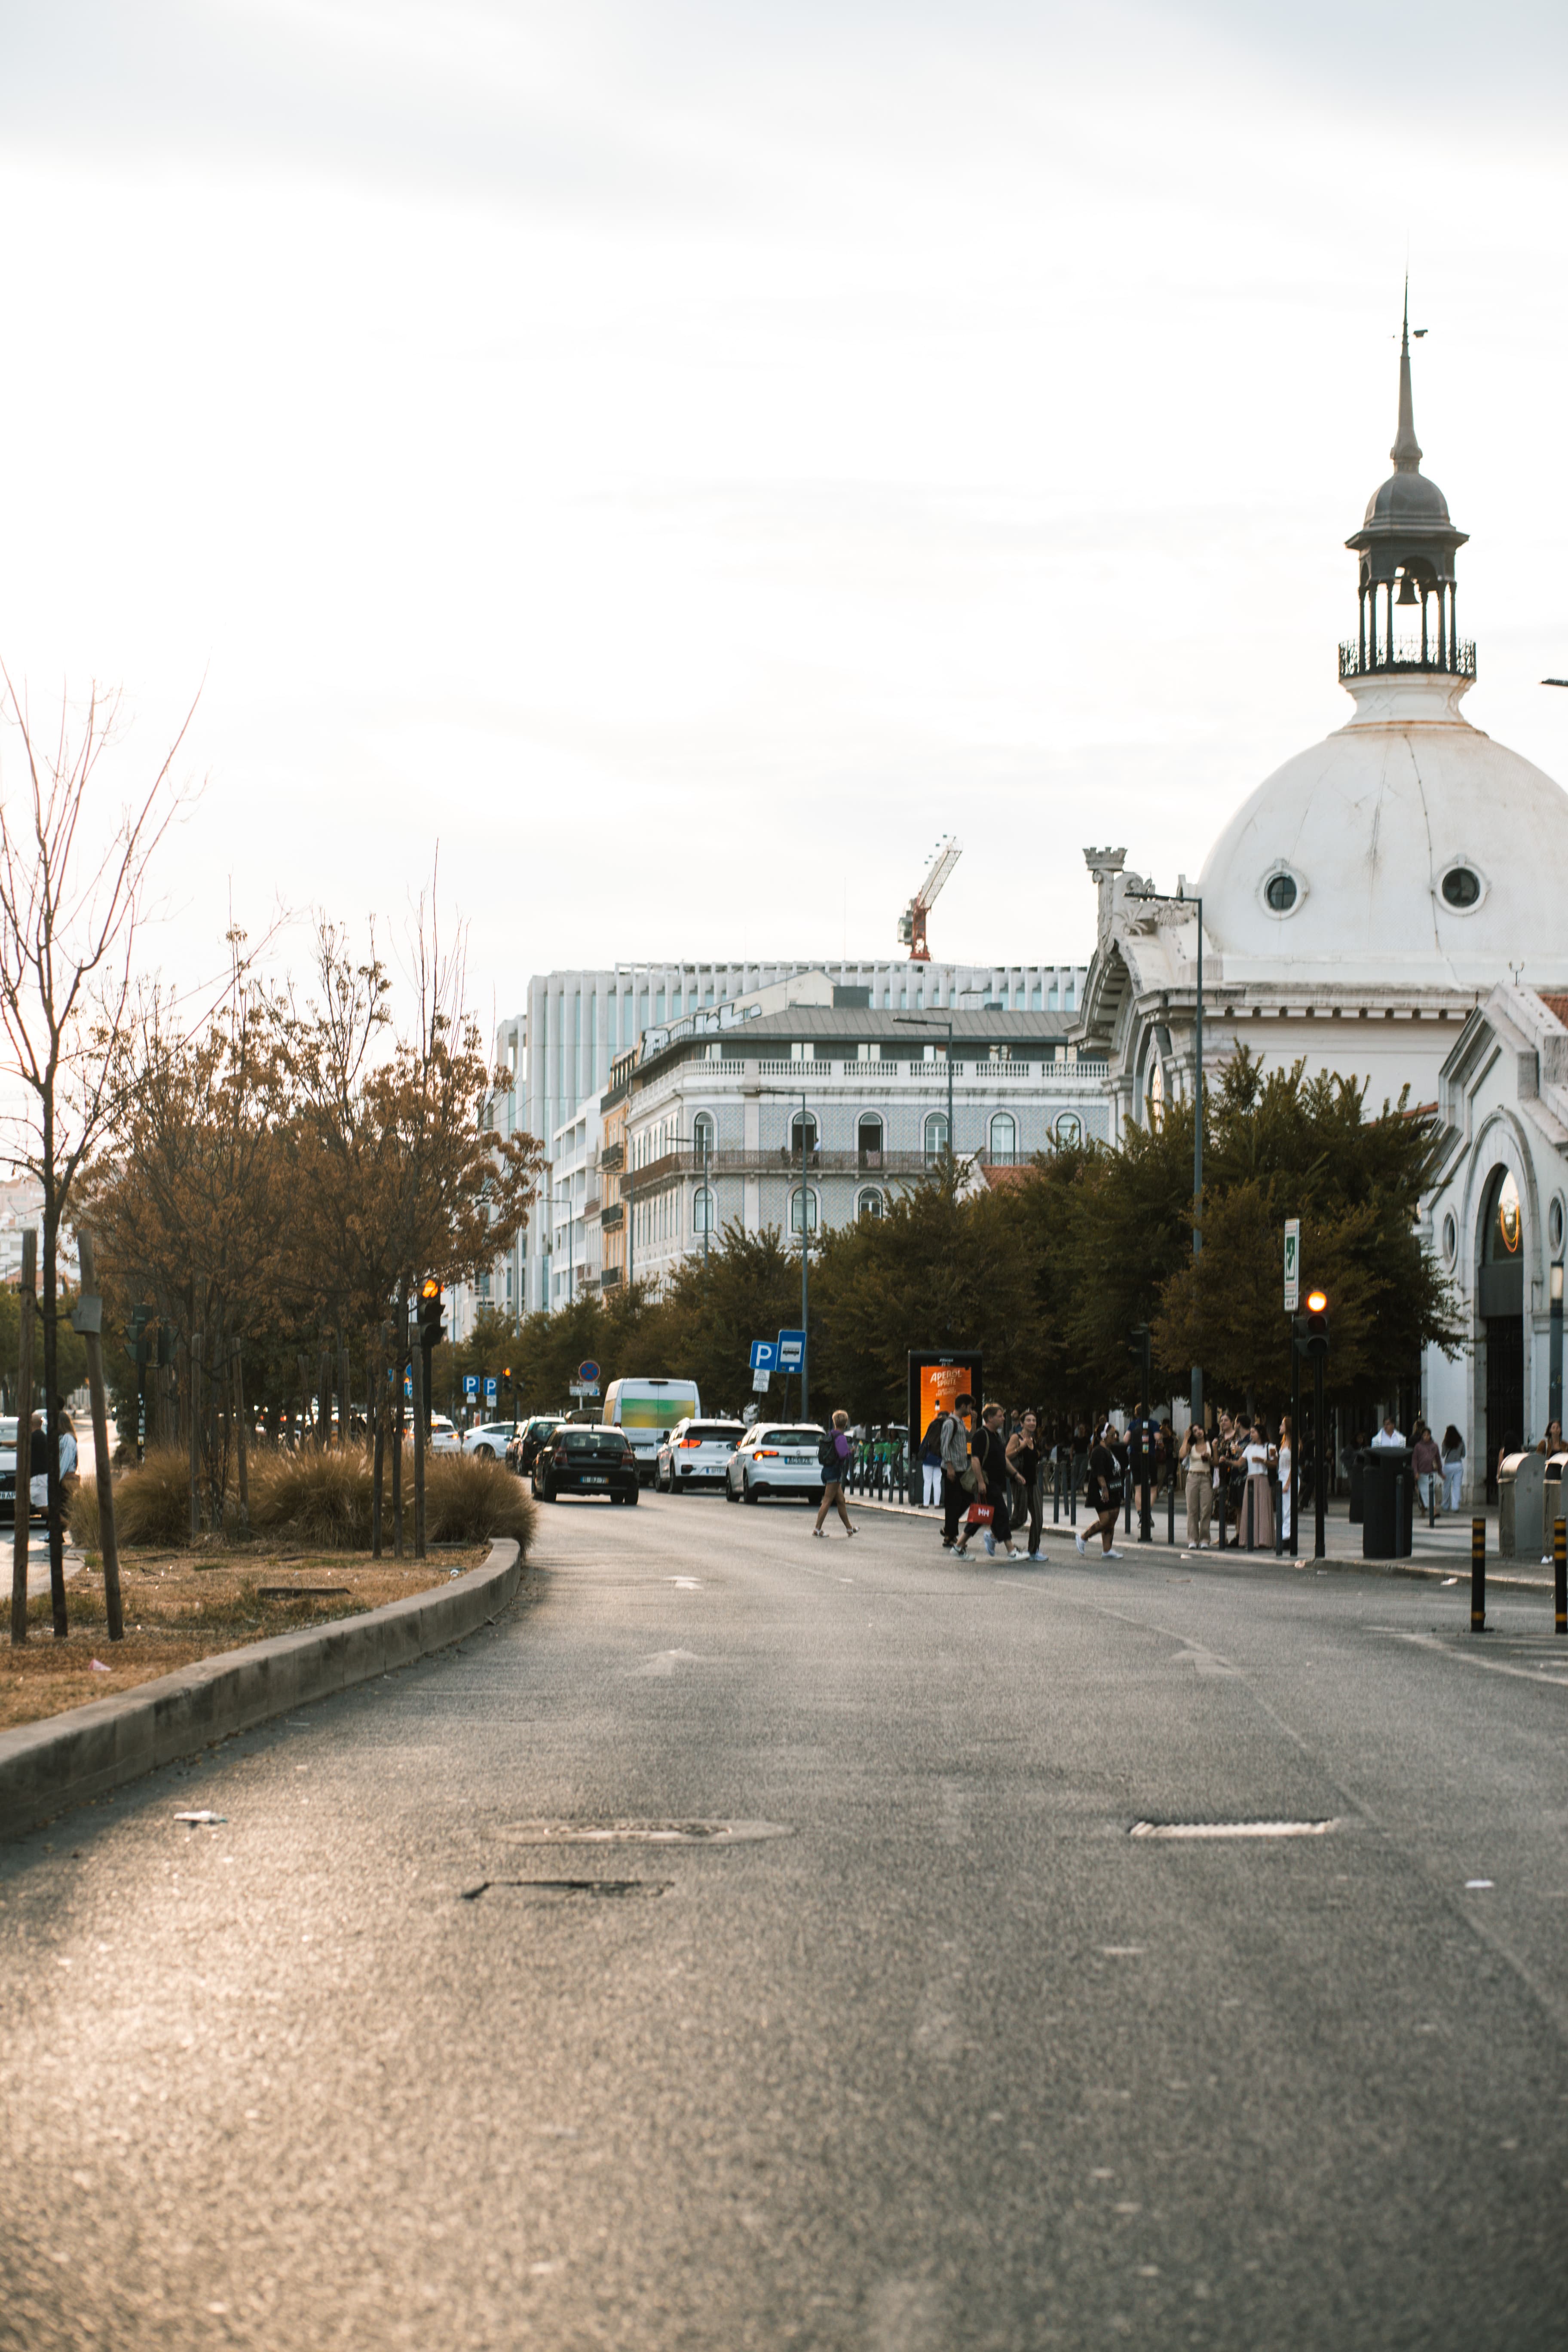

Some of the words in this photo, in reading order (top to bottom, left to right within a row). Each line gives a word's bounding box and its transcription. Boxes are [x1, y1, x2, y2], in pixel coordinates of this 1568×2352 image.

[756, 1344, 772, 1367] P
[930, 1369, 962, 1384] APEROL
[937, 1378, 956, 1388] SPRITZ
[466, 1378, 476, 1392] P
[487, 1380, 496, 1394] P
[978, 1507, 989, 1517] HH
